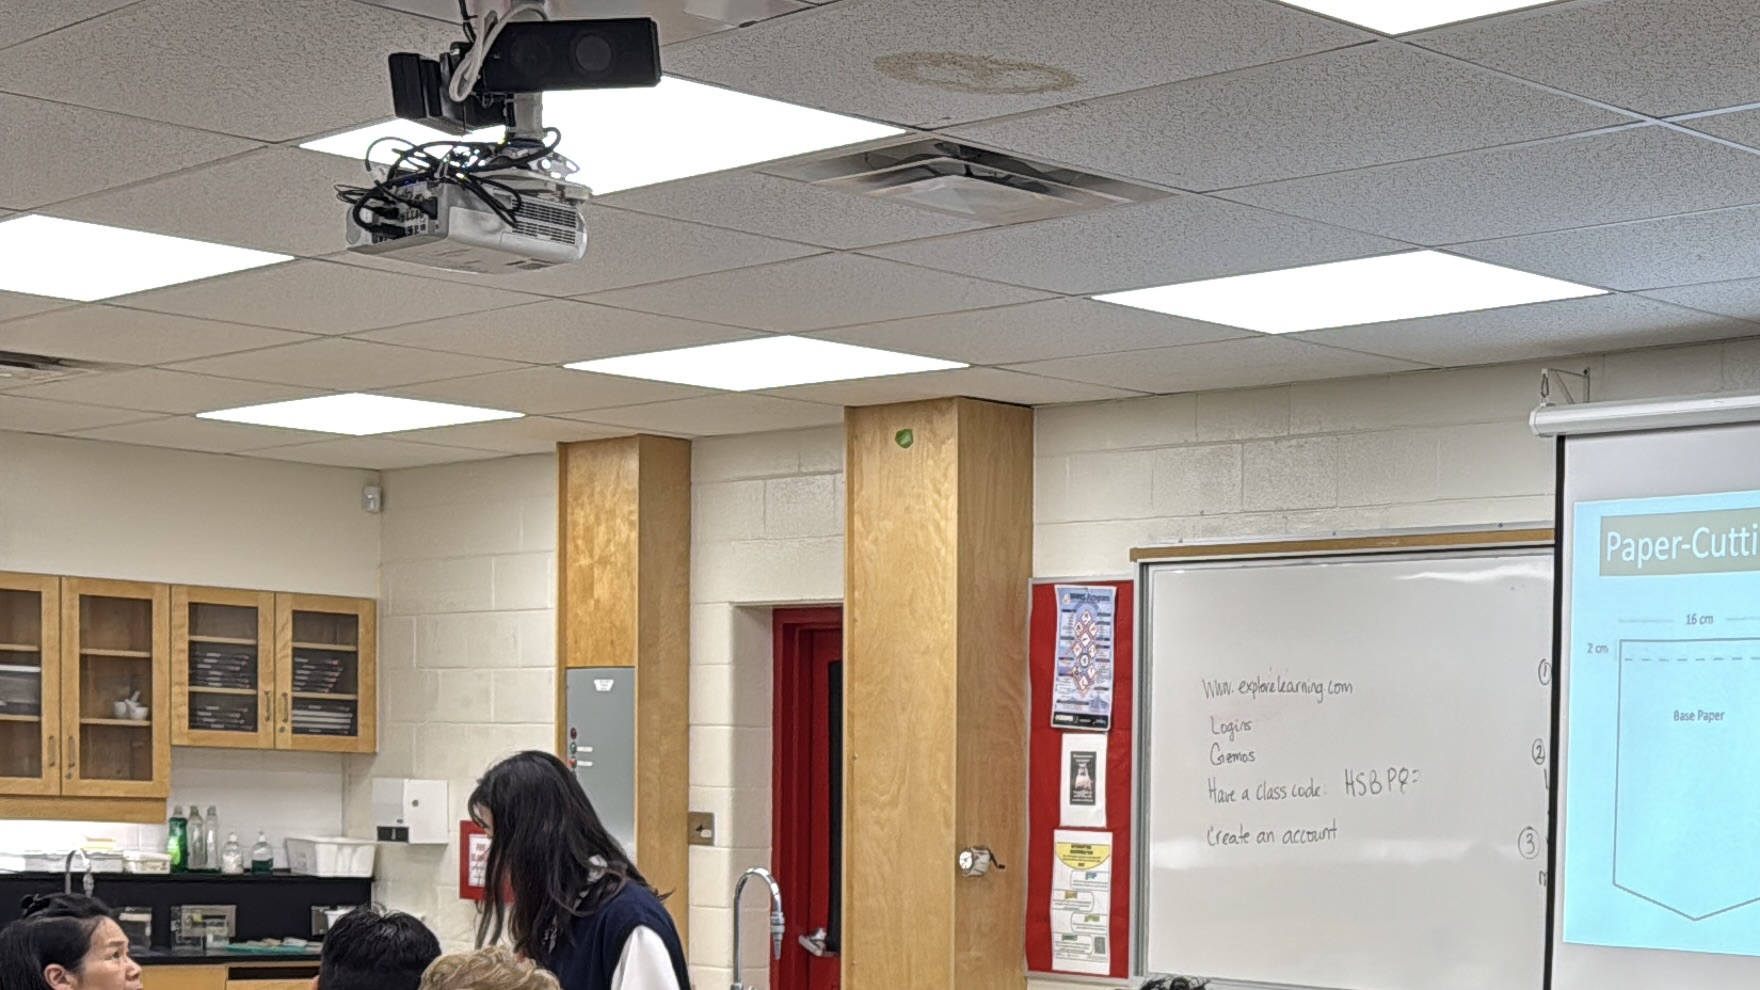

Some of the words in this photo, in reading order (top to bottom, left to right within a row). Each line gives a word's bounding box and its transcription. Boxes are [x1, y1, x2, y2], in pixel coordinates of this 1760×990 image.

[1686, 614, 1697, 625] 16
[1699, 615, 1714, 625] cm
[1587, 643, 1593, 654] 2
[1595, 644, 1609, 654] cm
[1673, 710, 1695, 722] Base
[1697, 710, 1725, 723] Paper
[1208, 777, 1236, 804] Have
[1241, 788, 1249, 800] a
[1256, 829, 1275, 844] an
[1282, 818, 1337, 844] account
